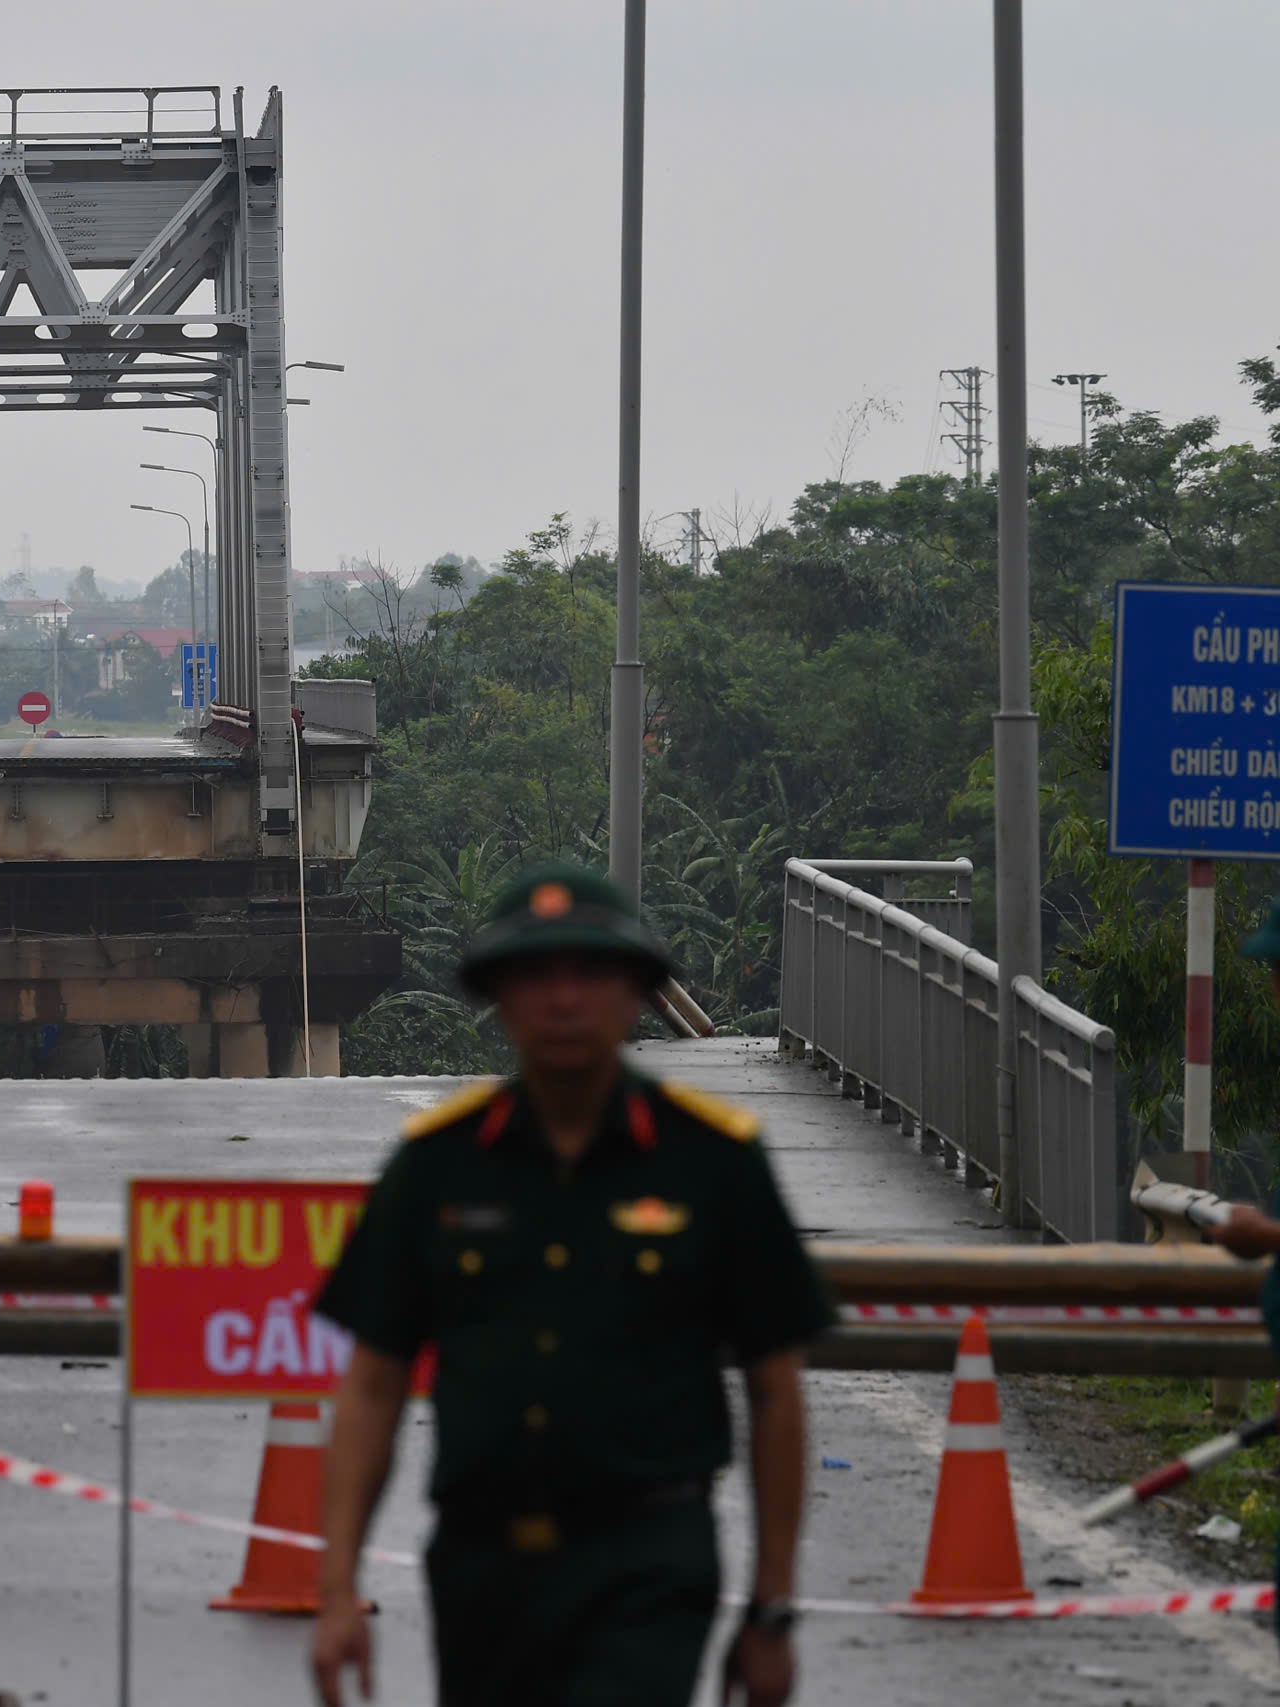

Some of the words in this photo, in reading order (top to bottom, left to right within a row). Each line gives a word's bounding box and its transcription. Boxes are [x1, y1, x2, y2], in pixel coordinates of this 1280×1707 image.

[1192, 610, 1240, 663] CẦU
[1247, 626, 1280, 664] PH
[1171, 685, 1234, 713] KM18
[1240, 695, 1255, 713] +
[1170, 736, 1238, 777] CHIỀU
[1168, 785, 1236, 829] CHIỀU
[136, 1199, 283, 1268] KHU
